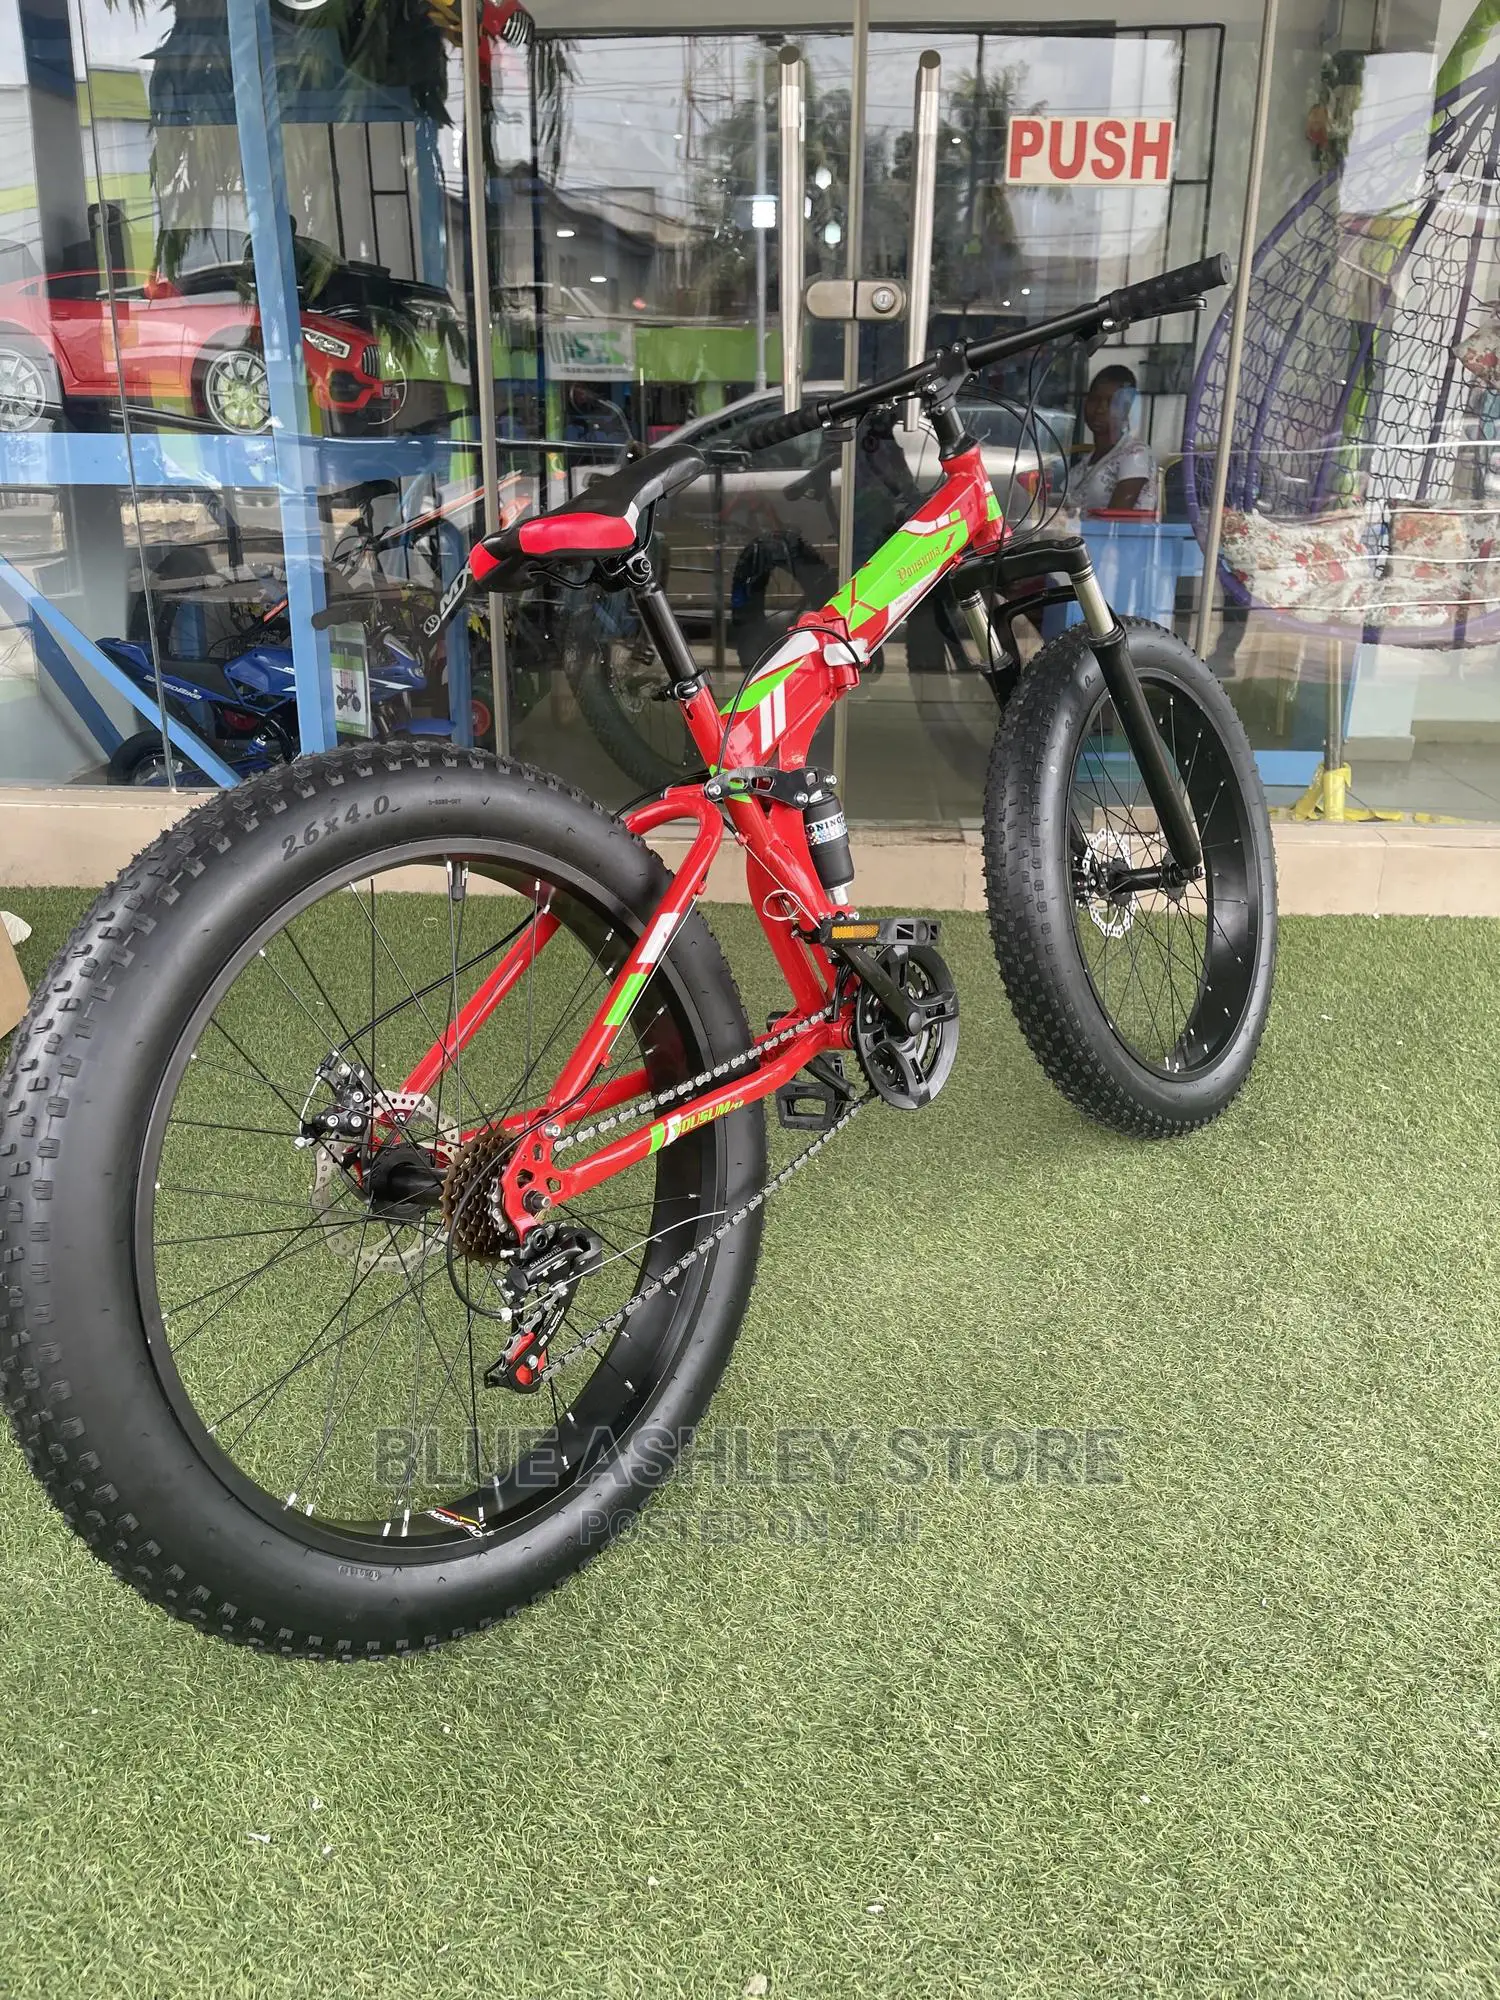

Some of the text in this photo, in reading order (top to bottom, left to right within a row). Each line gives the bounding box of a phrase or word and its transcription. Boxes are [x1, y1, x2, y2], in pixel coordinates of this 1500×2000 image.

[1009, 120, 1172, 180] PUSH
[281, 795, 391, 861] 26x4.0
[536, 1257, 568, 1277] TZ
